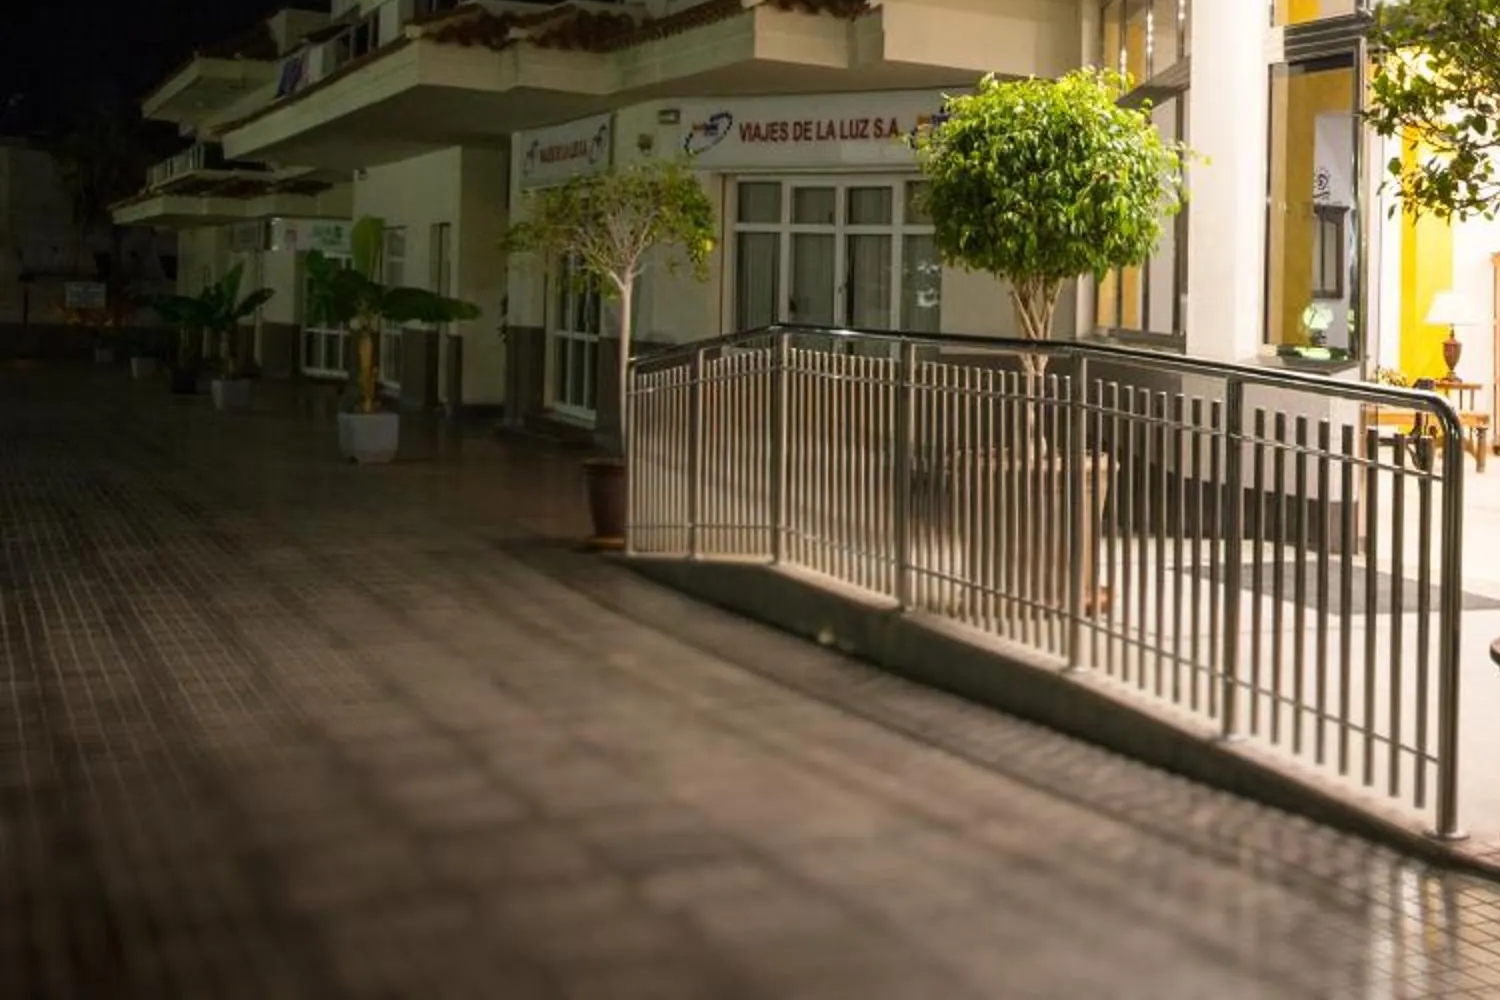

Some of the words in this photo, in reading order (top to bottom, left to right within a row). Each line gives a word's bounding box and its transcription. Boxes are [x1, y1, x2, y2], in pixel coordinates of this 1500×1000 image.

[739, 121, 789, 142] VIAJES
[792, 120, 813, 141] DE
[816, 119, 836, 140] LA
[840, 118, 870, 139] LUZ
